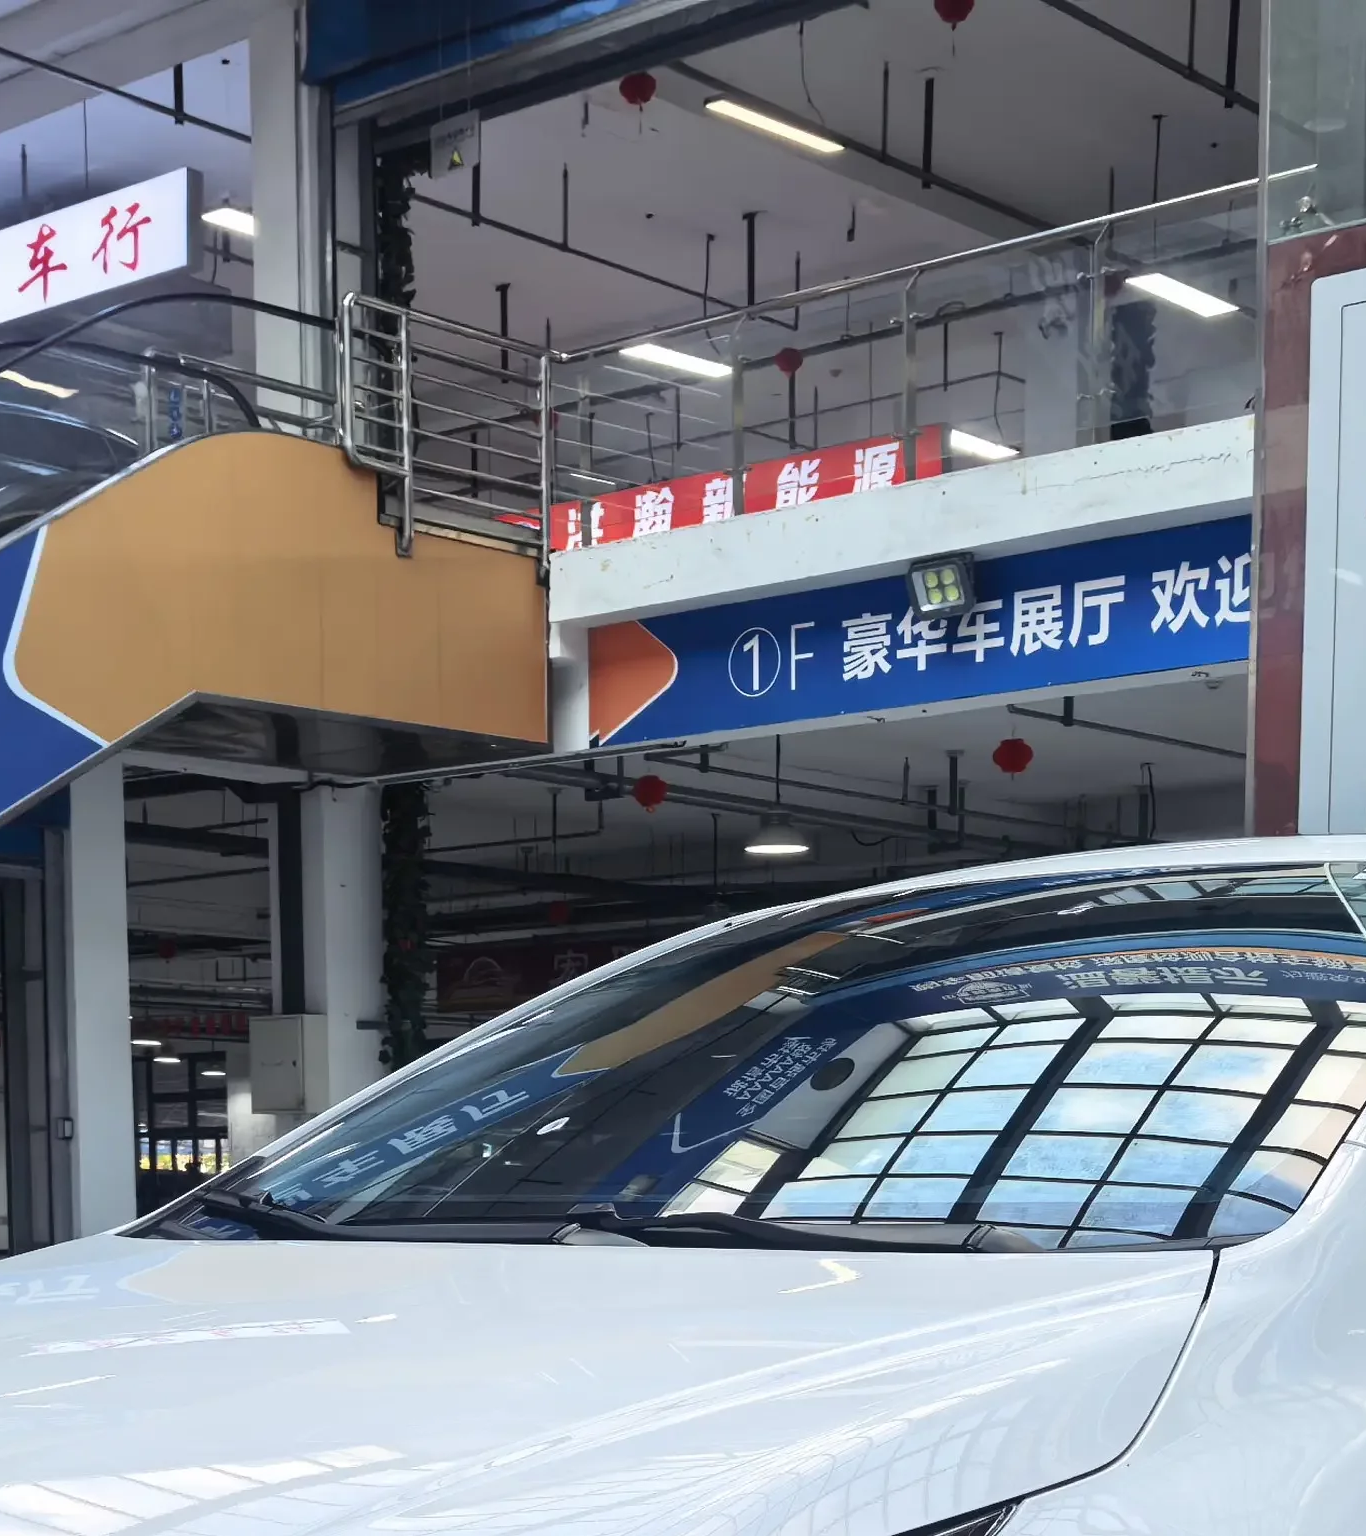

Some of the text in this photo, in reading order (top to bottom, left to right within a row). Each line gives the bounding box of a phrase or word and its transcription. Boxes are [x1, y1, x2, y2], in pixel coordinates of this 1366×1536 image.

[841, 574, 1126, 682] 豪华车展厅
